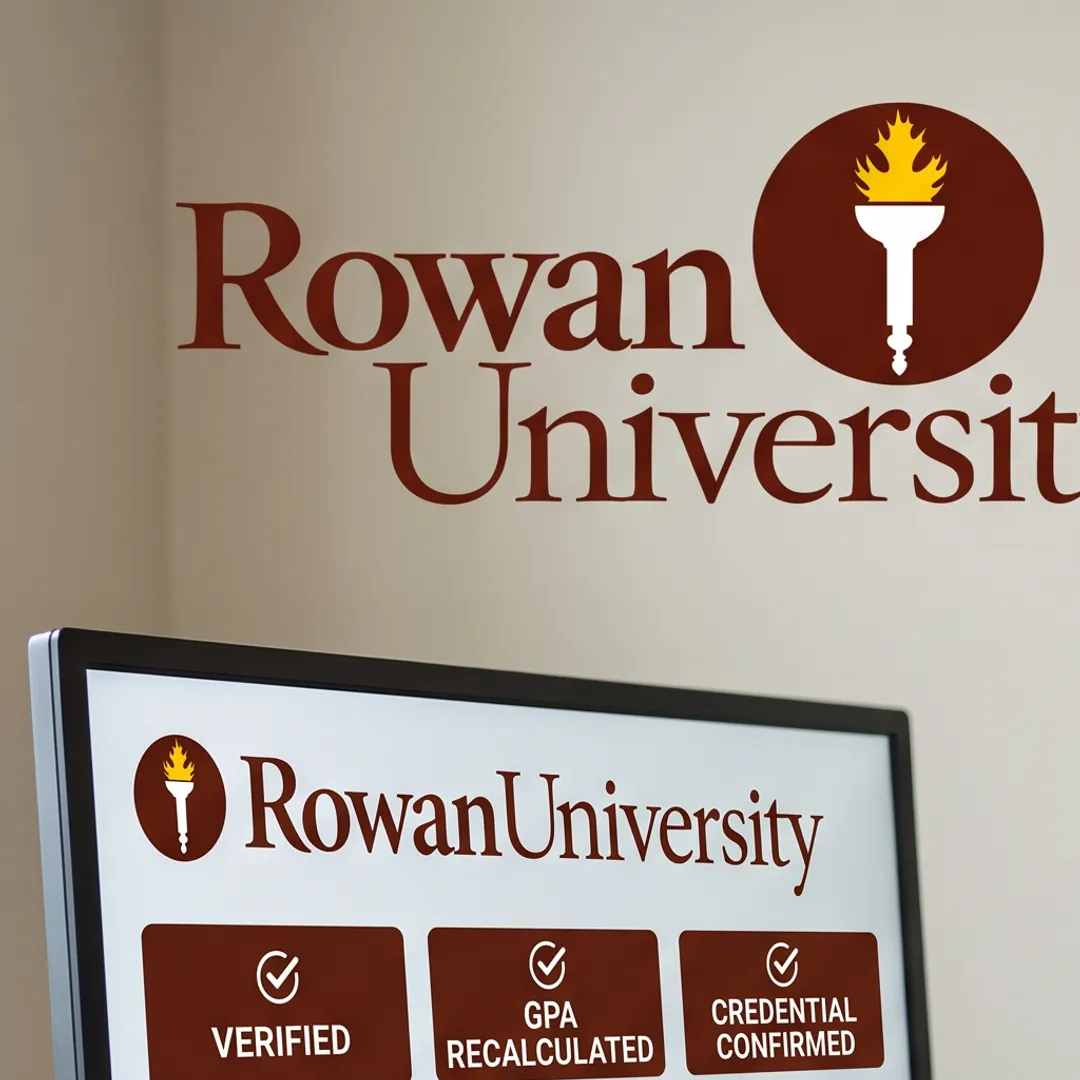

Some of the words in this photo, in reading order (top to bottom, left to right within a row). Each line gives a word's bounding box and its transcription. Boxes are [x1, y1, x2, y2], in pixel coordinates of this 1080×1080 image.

[175, 201, 746, 357] Rowan
[524, 1000, 579, 1030] GPA
[711, 996, 858, 1026] CREDENTIAL
[210, 1024, 351, 1059] VERIFIED
[446, 1035, 654, 1069] RECALCULATED
[716, 1029, 856, 1060] CONFIRMED
